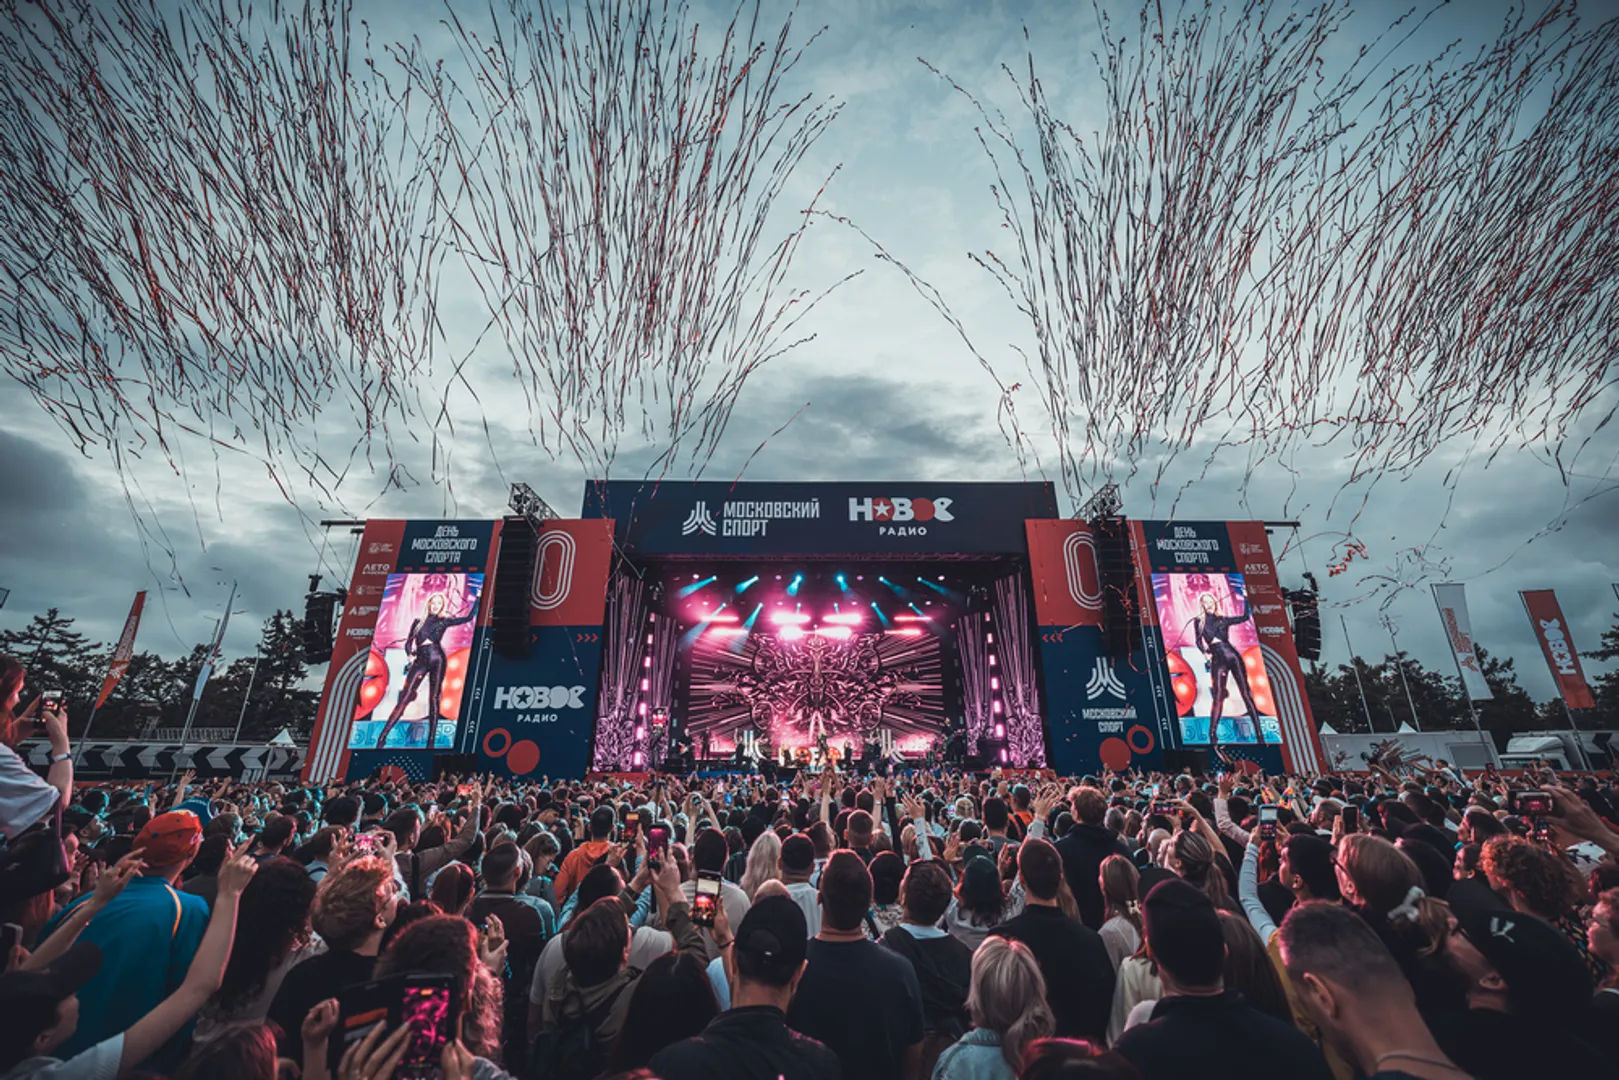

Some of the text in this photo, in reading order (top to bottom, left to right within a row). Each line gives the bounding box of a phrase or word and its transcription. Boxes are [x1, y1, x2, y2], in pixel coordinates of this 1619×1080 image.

[723, 498, 820, 519] МОСКОВСКИЙ
[434, 525, 460, 538] ДЕНЬ
[722, 519, 768, 537] СПОРТ
[878, 525, 928, 536] РАДИО
[1174, 526, 1196, 539] ДЕНЬ
[411, 538, 477, 551] МОСКОВСКОГО
[1156, 539, 1219, 551] МОСКОВСКОГО
[424, 551, 461, 564] СПОРТА
[1174, 552, 1209, 564] СПОРТА
[363, 563, 390, 571] ЛЕТО
[516, 713, 558, 723] РАДИО
[1082, 705, 1137, 720] МОСКОВСКИЙ
[1098, 719, 1125, 733] СПОРТ
